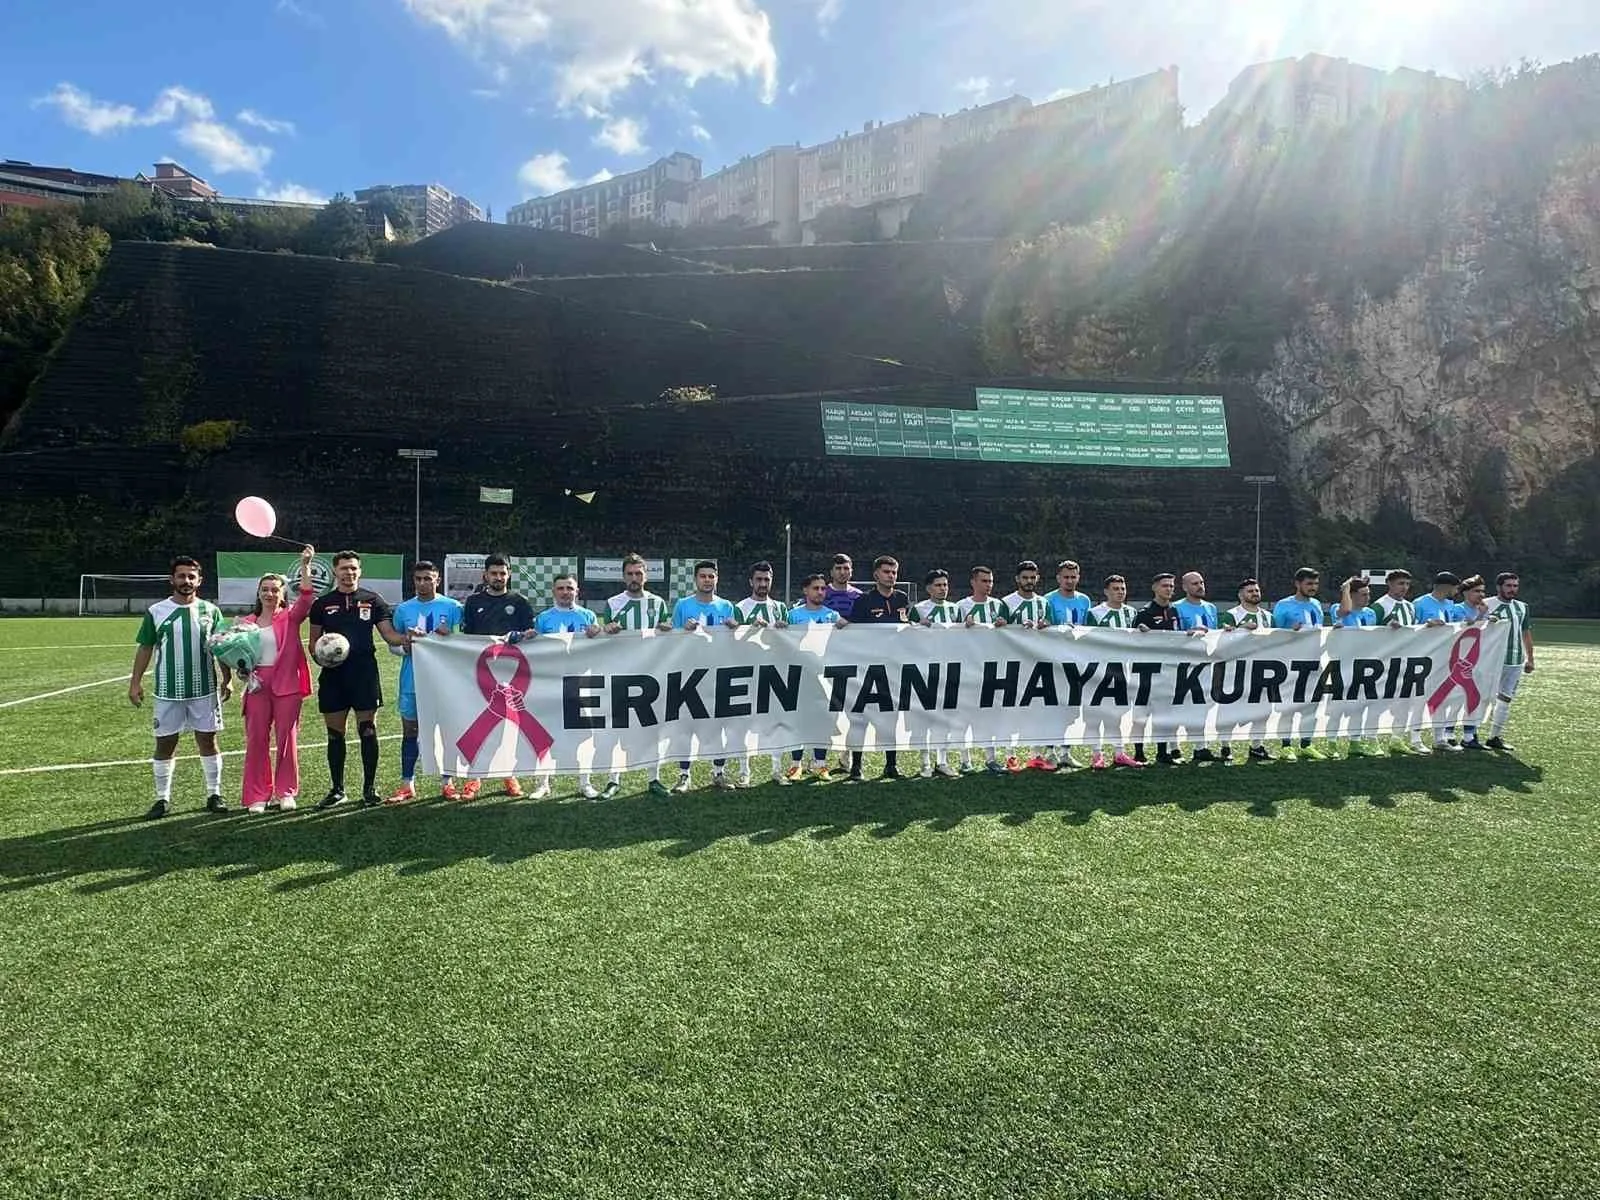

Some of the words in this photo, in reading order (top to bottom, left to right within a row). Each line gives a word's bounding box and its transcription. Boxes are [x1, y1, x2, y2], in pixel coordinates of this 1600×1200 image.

[562, 665, 801, 729] ERKEN
[823, 661, 961, 713] TANI
[979, 661, 1162, 709] HAYAT
[1172, 656, 1433, 705] KURTARIR
